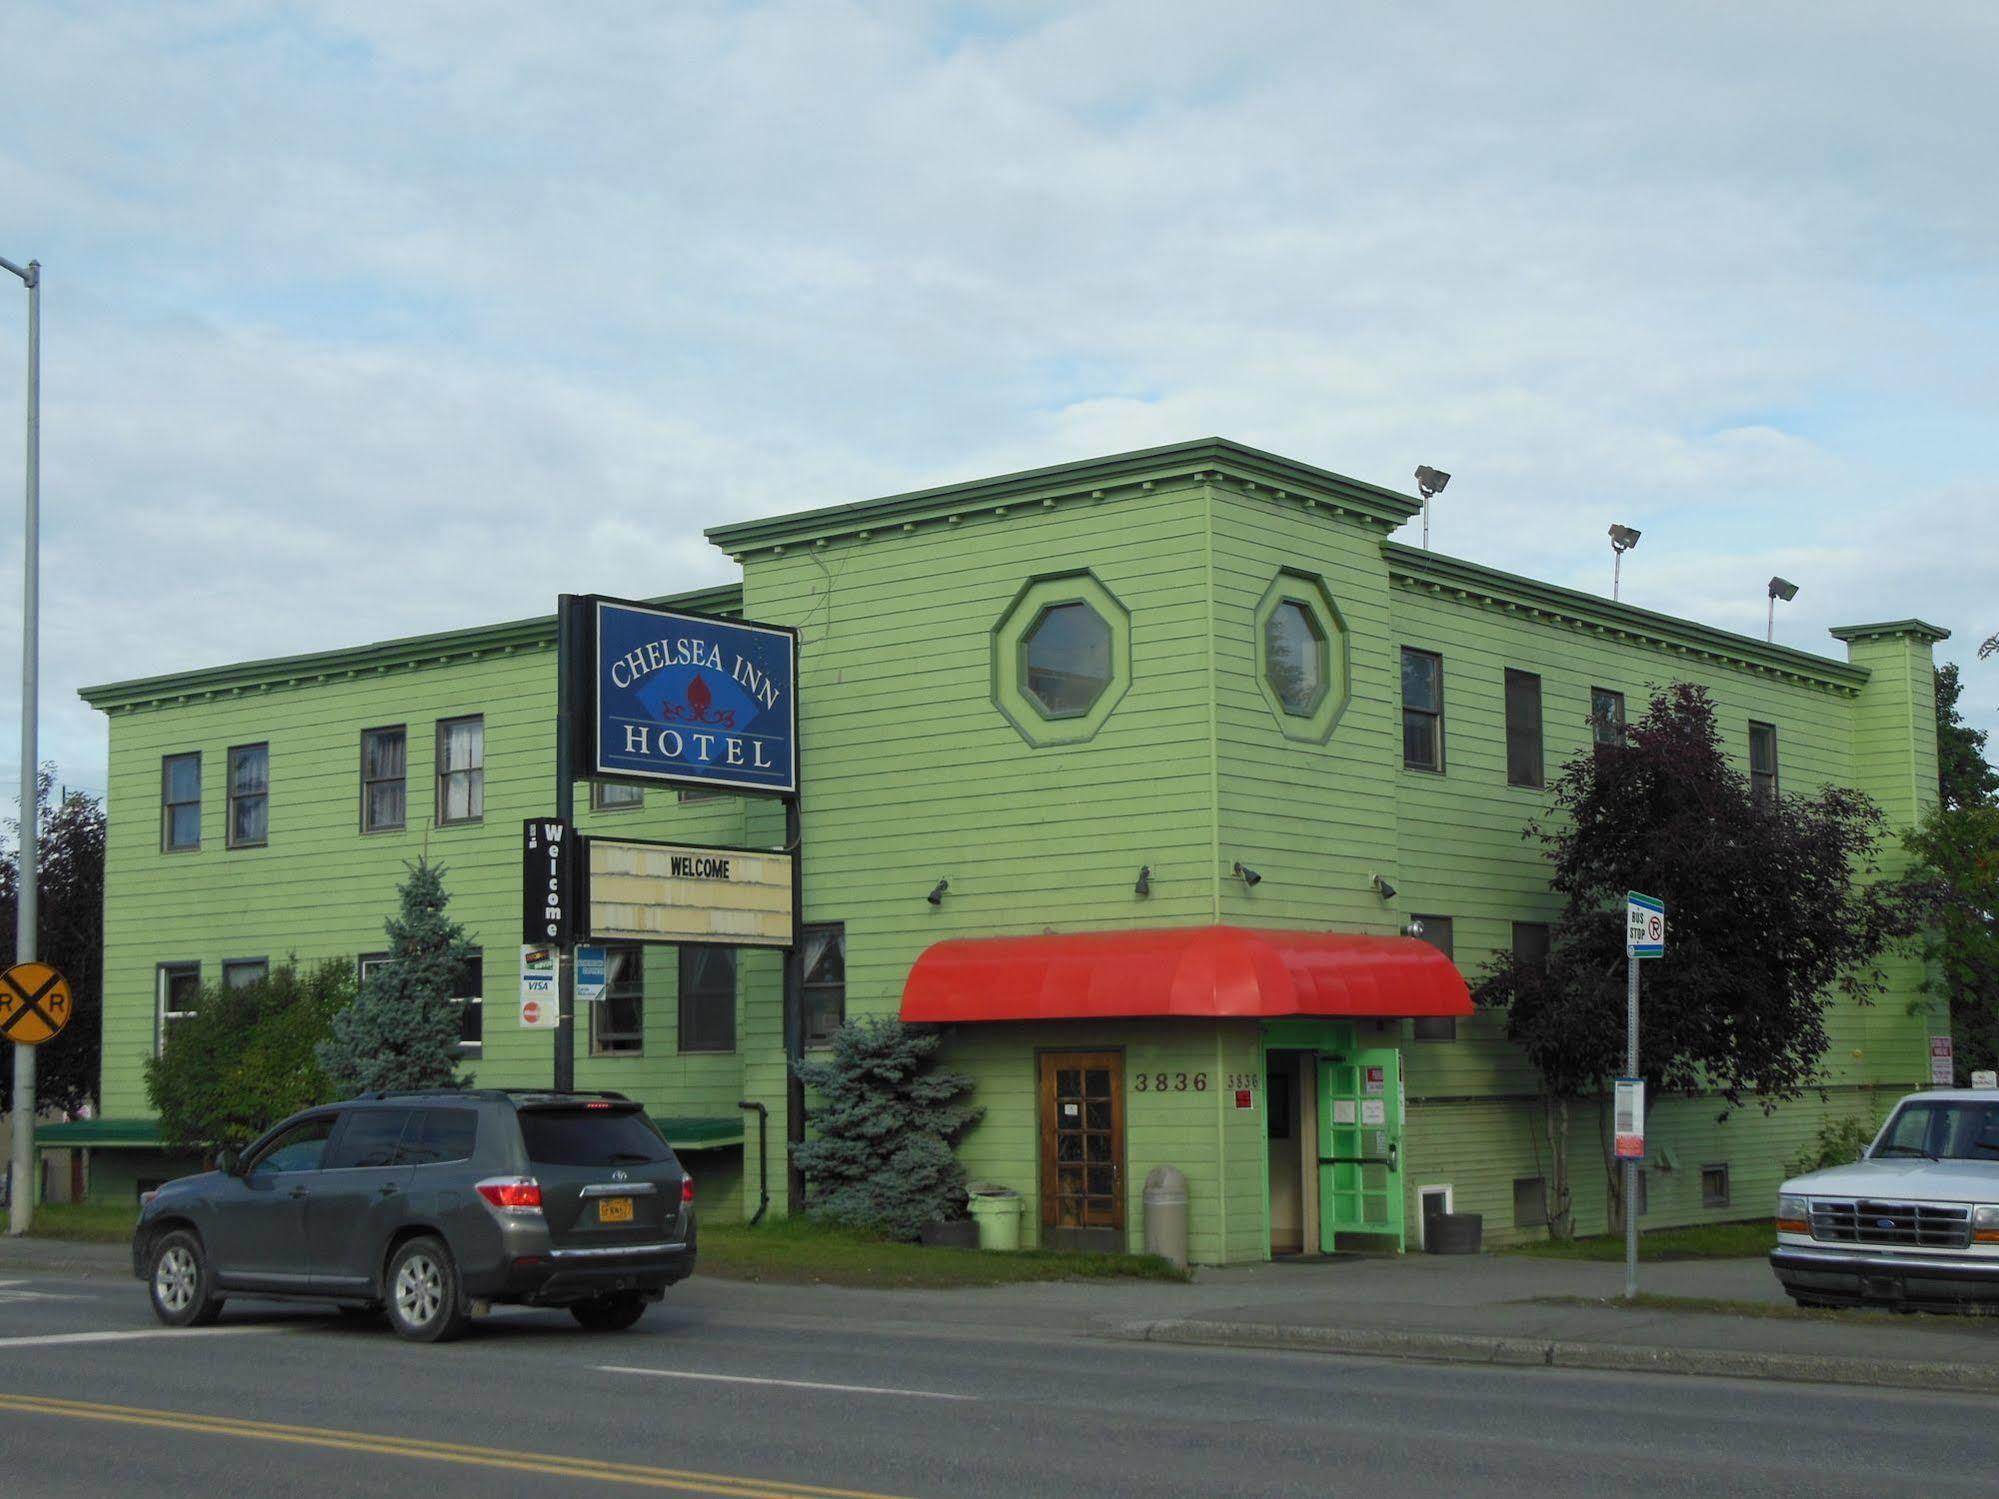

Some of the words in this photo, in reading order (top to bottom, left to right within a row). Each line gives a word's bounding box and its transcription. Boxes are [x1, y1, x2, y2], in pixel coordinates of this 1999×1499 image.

[611, 638, 723, 689] CHELSEA
[732, 654, 781, 711] INN
[624, 724, 772, 769] HOTEL
[671, 856, 730, 879] WELCOME
[544, 823, 564, 937] Welcome
[1631, 911, 1644, 924] BUS
[1629, 927, 1645, 940] STOP
[528, 982, 548, 991] VISA
[49, 993, 65, 1012] R
[1135, 1072, 1207, 1092] 3836
[1227, 1073, 1259, 1089] 3836
